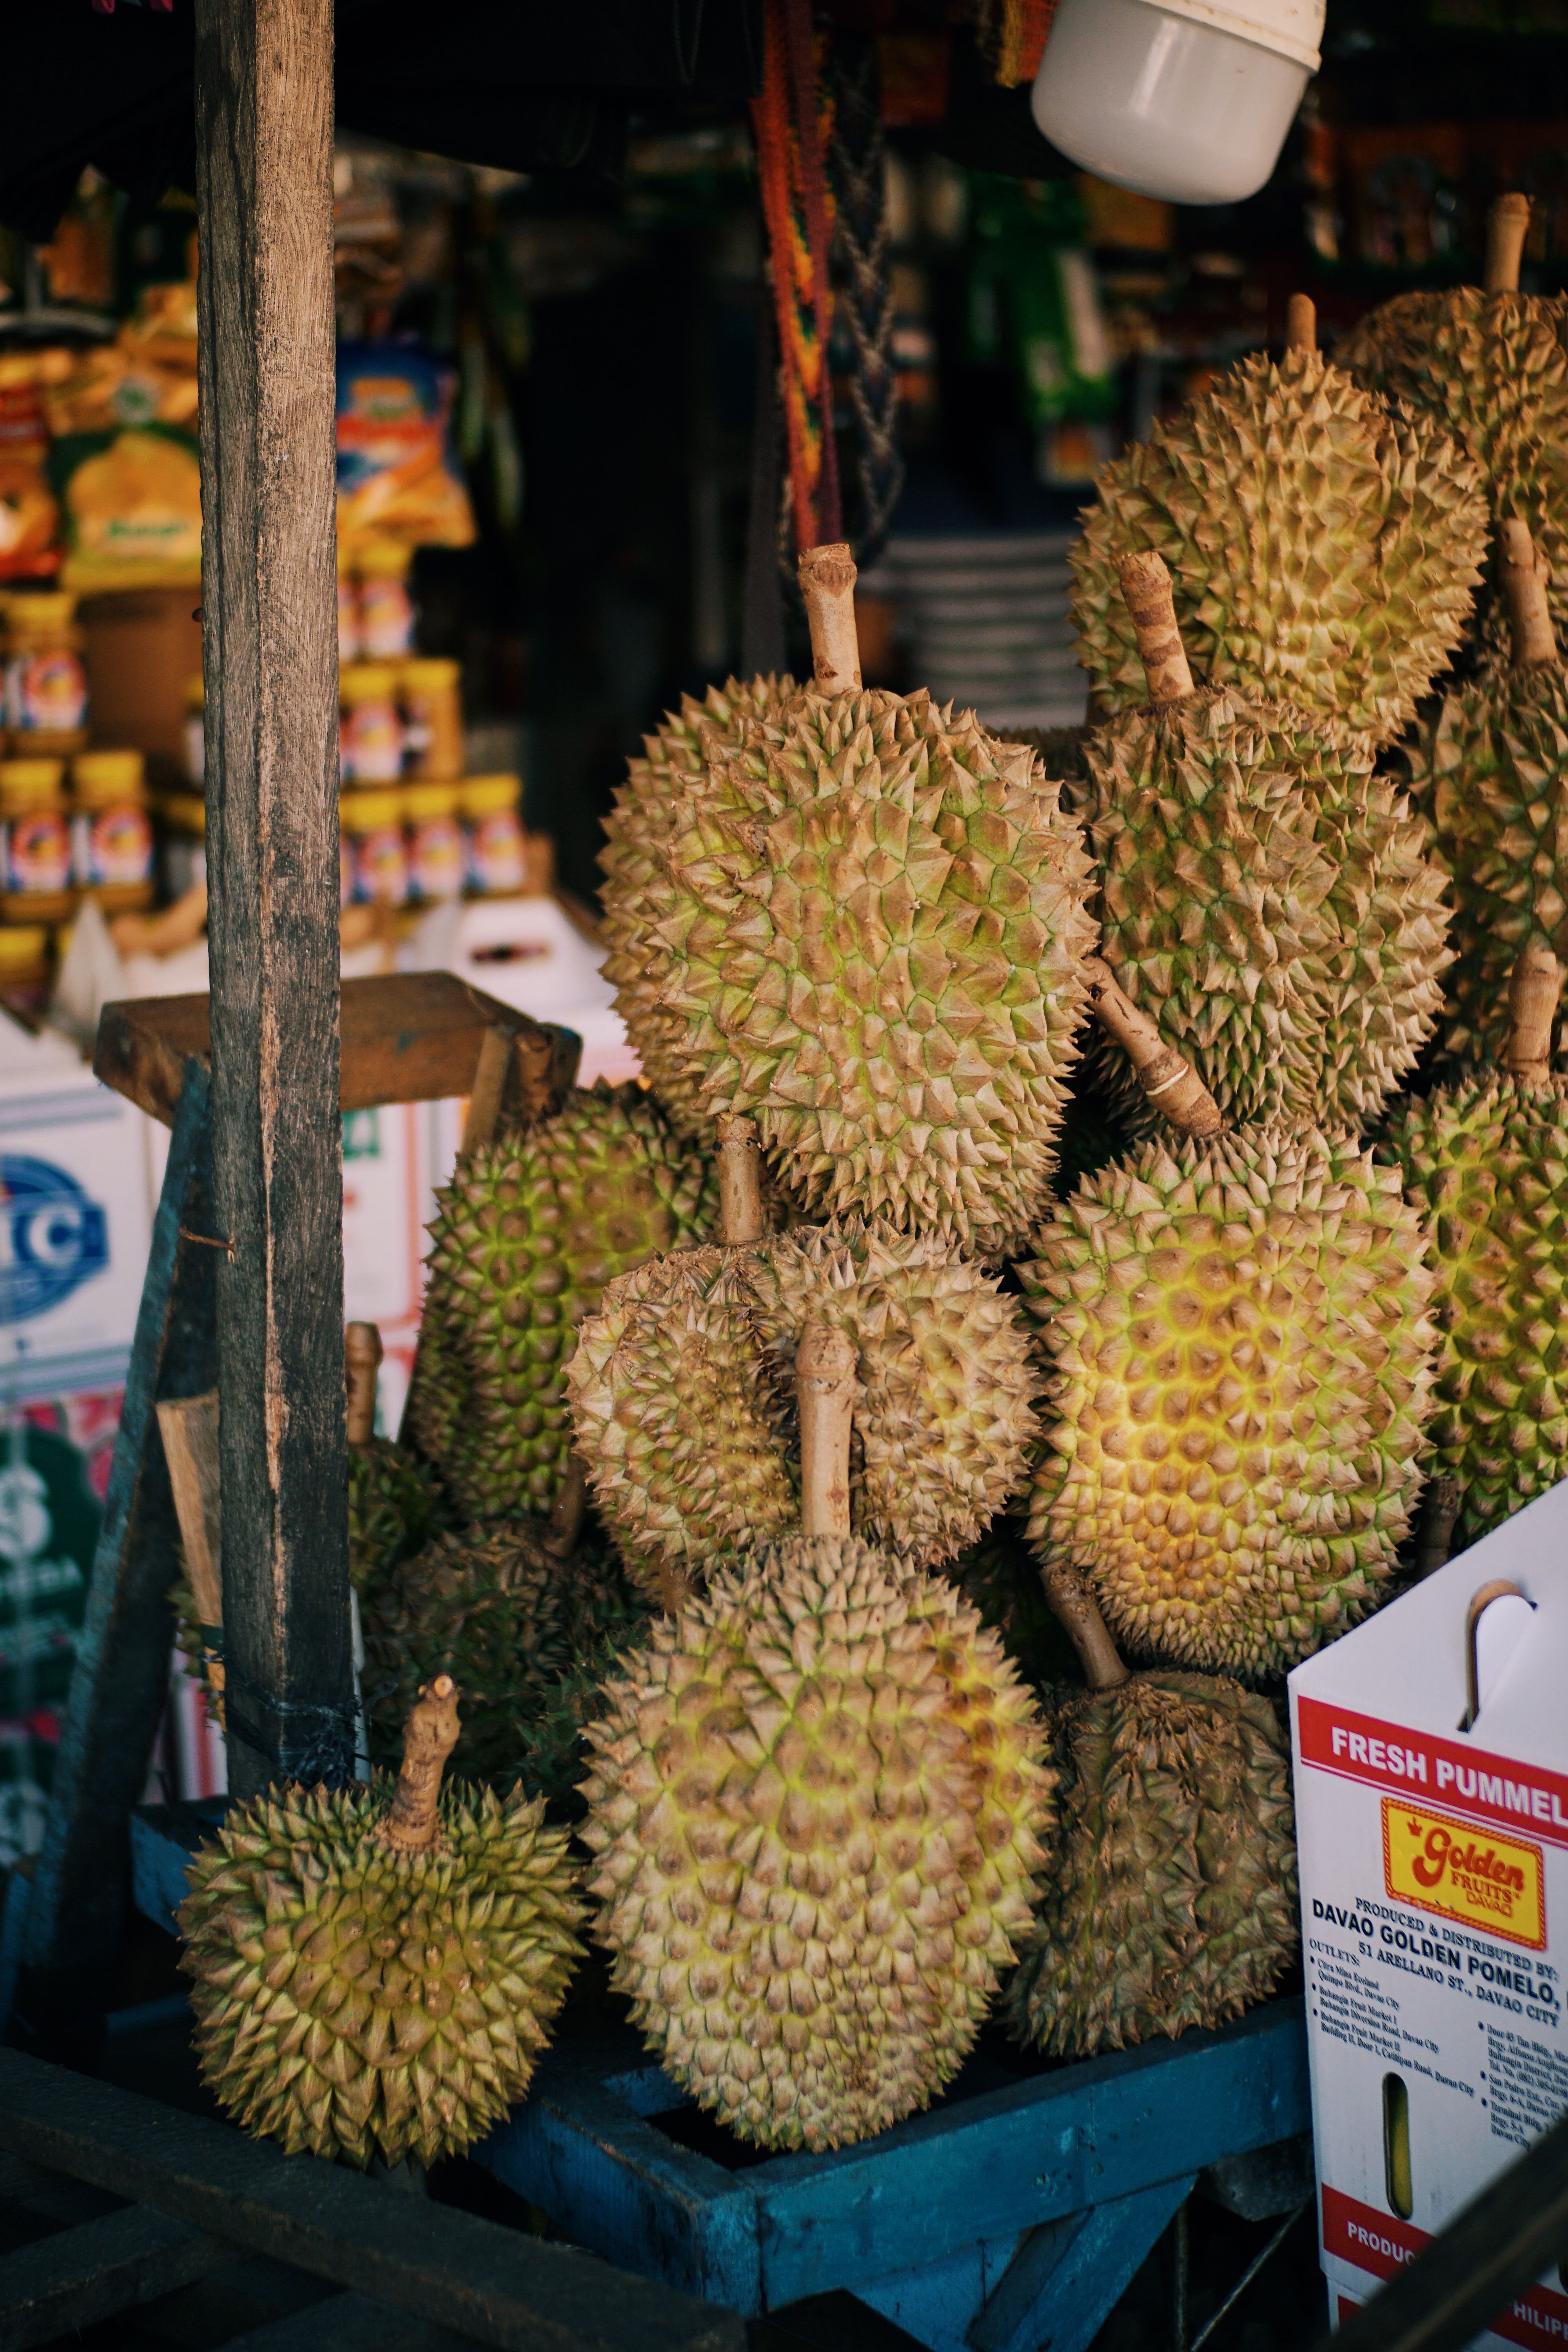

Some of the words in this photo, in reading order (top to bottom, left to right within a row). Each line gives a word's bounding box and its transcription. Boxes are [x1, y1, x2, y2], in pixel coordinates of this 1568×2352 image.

[1332, 1726, 1427, 1783] FRESH
[1436, 1758, 1568, 1828] PUMMEL
[1466, 1890, 1513, 1918] DAVAO
[1309, 1938, 1360, 1967] OUTLETS:
[1355, 1896, 1424, 1931] PRODUCED
[1429, 1923, 1438, 1937] &
[1442, 1927, 1531, 1970] DISTRIBUTED
[1535, 1961, 1559, 1982] BY:
[1312, 1898, 1374, 1936] DAVAO
[1380, 1924, 1460, 1969] GOLDEN
[1468, 1955, 1560, 2011] POMELO,
[1359, 1941, 1373, 1958] 51
[1377, 1948, 1443, 1984] ARELLANO
[1476, 1984, 1522, 2013] DAVAO
[1526, 2004, 1559, 2027] CITY
[1365, 1987, 1385, 2004] Davao
[1386, 1996, 1399, 2011] City
[1319, 1984, 1349, 2005] Buhangin
[1350, 1997, 1367, 2013] Fruit
[1368, 2004, 1392, 2022] Market
[1320, 1996, 1349, 2016] Buhangin
[1351, 2009, 1381, 2029] Diversion
[1382, 2021, 1402, 2039] Road,
[1403, 2030, 1424, 2047] Davao
[1425, 2039, 1439, 2055] City
[1321, 2011, 1350, 2031] Buhangin
[1352, 2023, 1368, 2038] Fruit
[1369, 2030, 1393, 2048] Market
[1487, 2023, 1504, 2038] Door
[1516, 2034, 1530, 2048] Tan
[1321, 2022, 1347, 2043] Building
[1357, 2037, 1373, 2052] Door
[1414, 2060, 1434, 2078] Road,
[1435, 2071, 1458, 2089] Davao
[1459, 2080, 1474, 2098] City
[1488, 2035, 1506, 2052] Brgy.
[1508, 2044, 1534, 2061] Alfonso
[1488, 2047, 1522, 2069] Buhangin
[1523, 2060, 1552, 2082] District,
[1488, 2058, 1501, 2073] Tel.
[1503, 2064, 1514, 2078] No.
[1517, 2070, 1534, 2086] (082)
[1489, 2073, 1502, 2087] San
[1504, 2078, 1524, 2096] Pedro
[1490, 2085, 1508, 2102] Brgy.
[1526, 2100, 1549, 2116] Davao
[1490, 2099, 1521, 2121] Terminal
[1491, 2111, 1508, 2129] Brgy.
[1491, 2123, 1513, 2140] Davao
